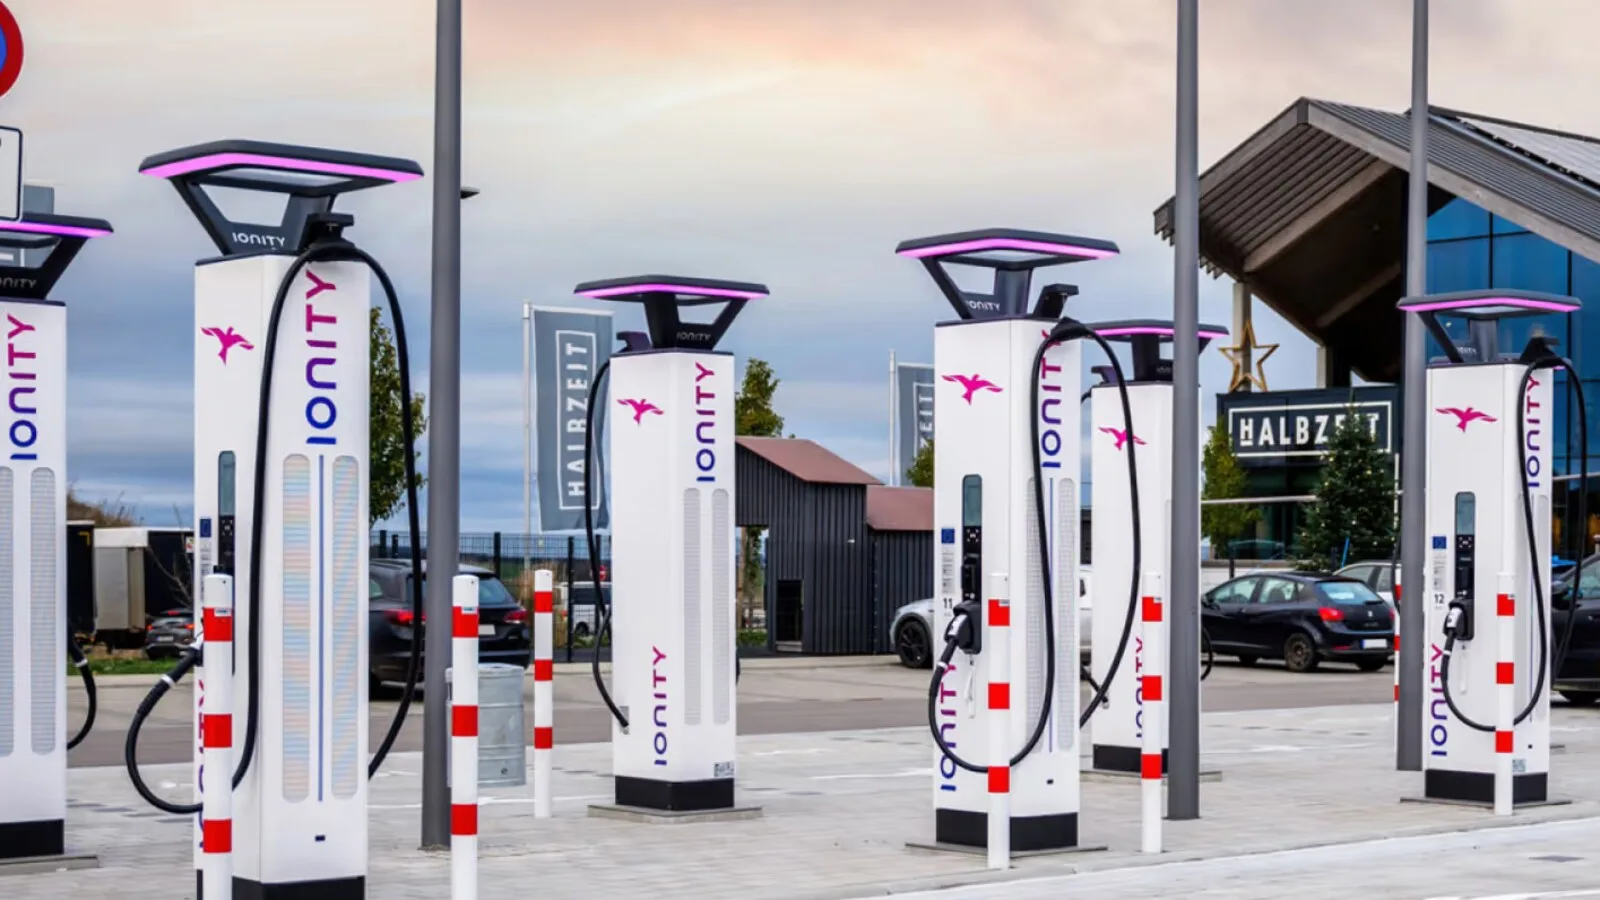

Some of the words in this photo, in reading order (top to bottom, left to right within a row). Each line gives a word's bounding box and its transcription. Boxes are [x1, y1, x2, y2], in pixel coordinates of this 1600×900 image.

[232, 232, 285, 247] IONITY
[8, 313, 38, 460] IONITY
[305, 269, 338, 445] IONITY
[695, 361, 716, 482] IONITY
[1239, 412, 1380, 447] HALBZET
[1526, 375, 1541, 488] IONITY
[1434, 594, 1445, 604] 12
[652, 645, 668, 766] IONITY
[1430, 643, 1448, 757] IONITY
